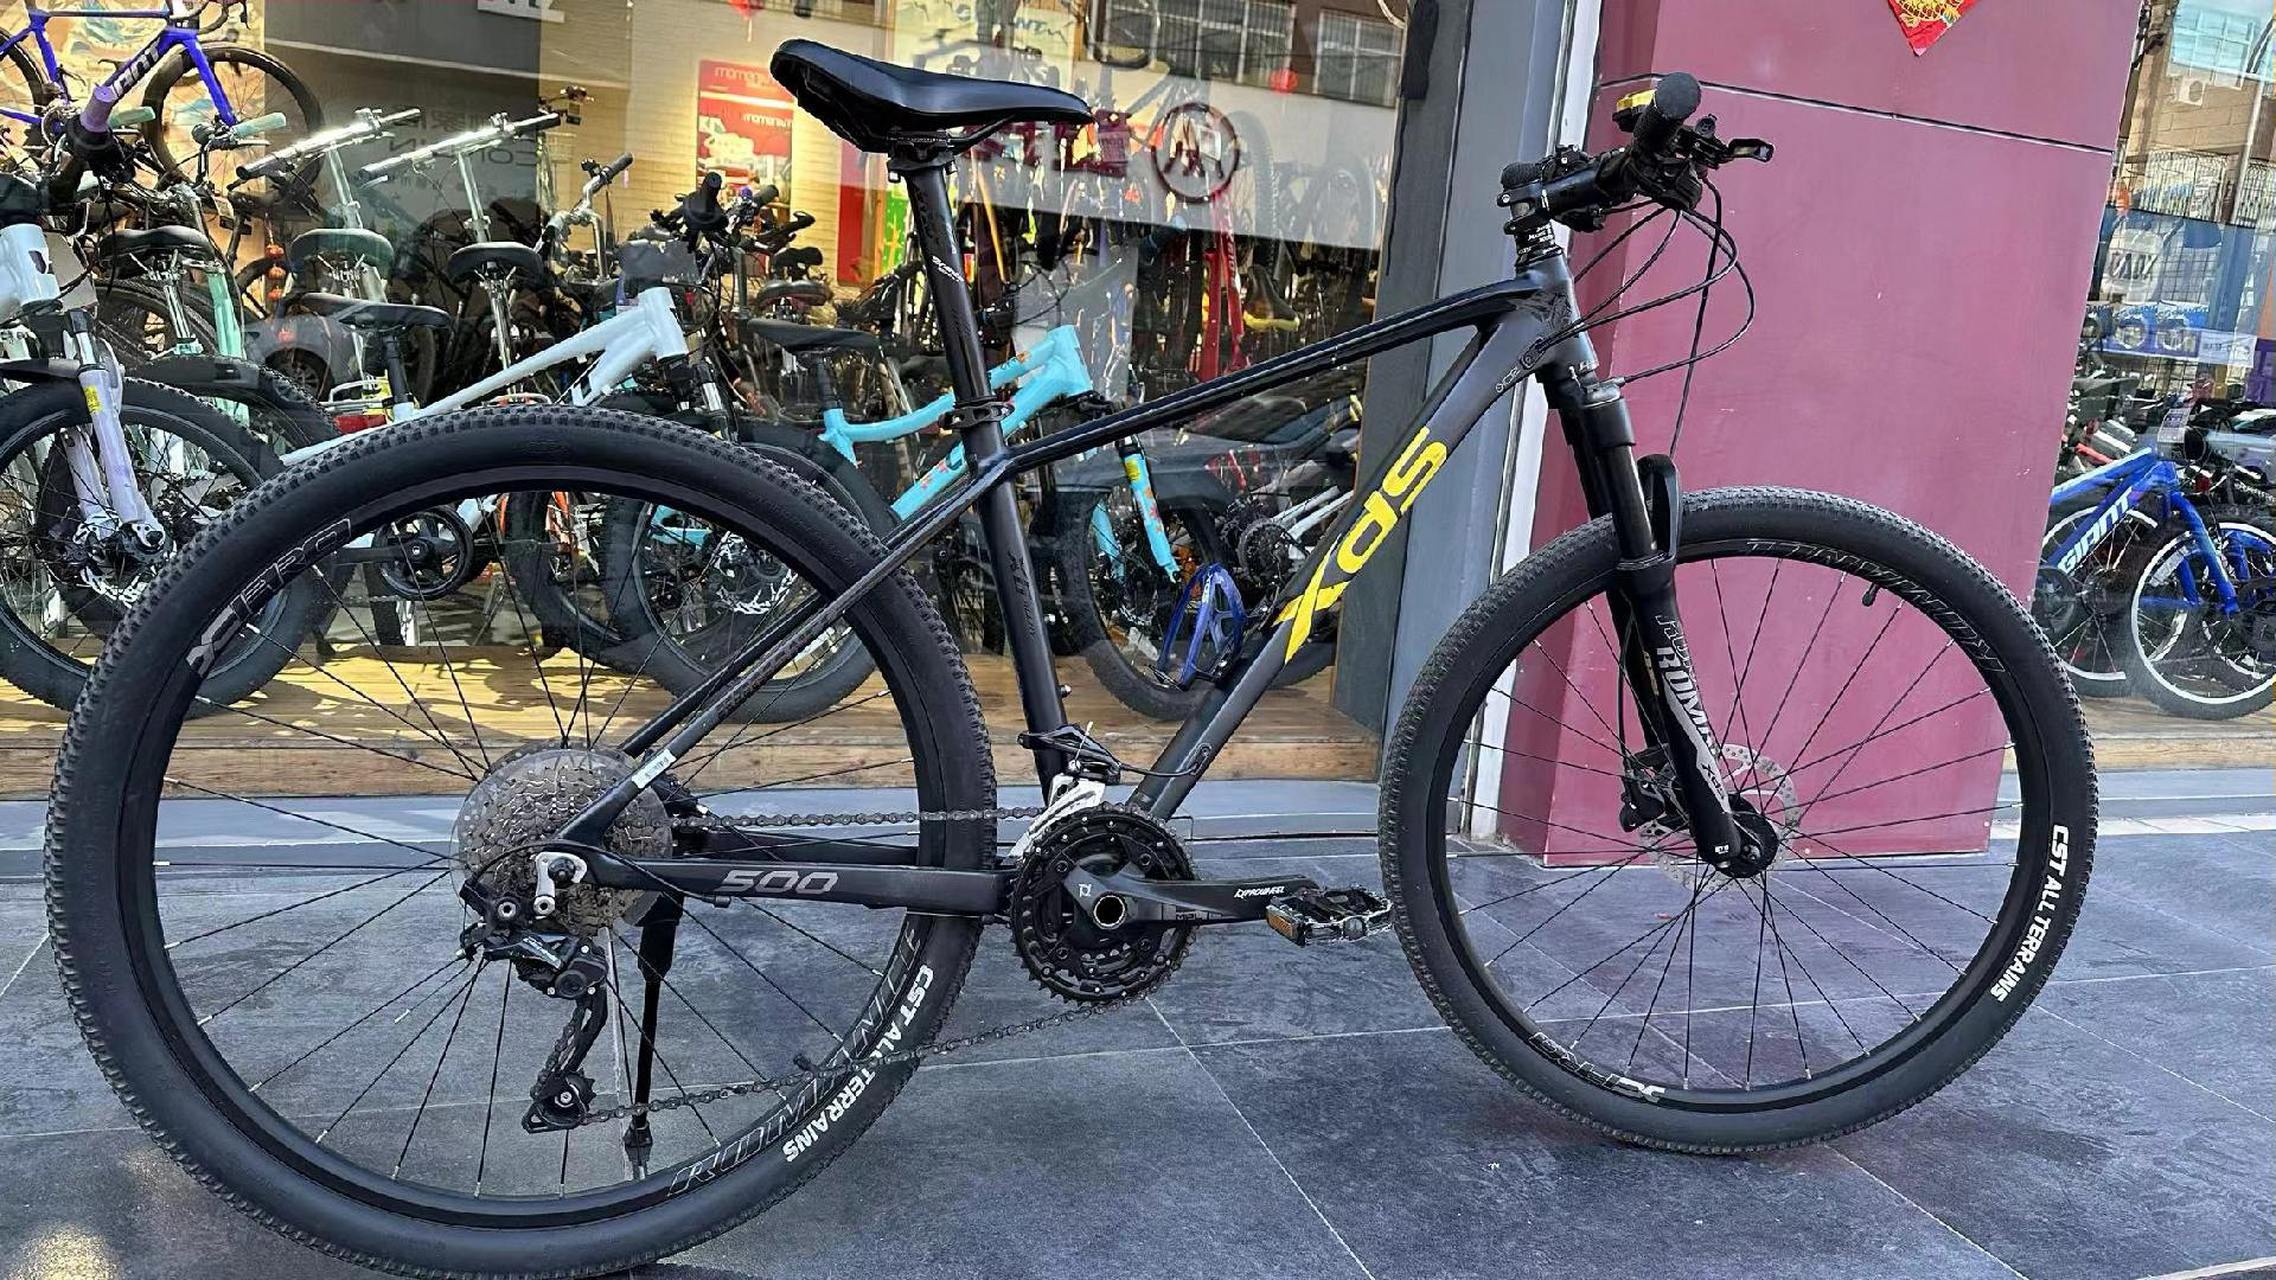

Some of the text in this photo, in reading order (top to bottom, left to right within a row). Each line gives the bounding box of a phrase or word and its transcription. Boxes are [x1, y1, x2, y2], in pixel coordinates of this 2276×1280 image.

[2057, 486, 2133, 574] GIANT
[717, 870, 838, 895] 500
[1990, 824, 2069, 1002] CST ALL TERRAINS
[900, 964, 935, 1026] CST
[782, 1068, 876, 1163] TERRAINS
